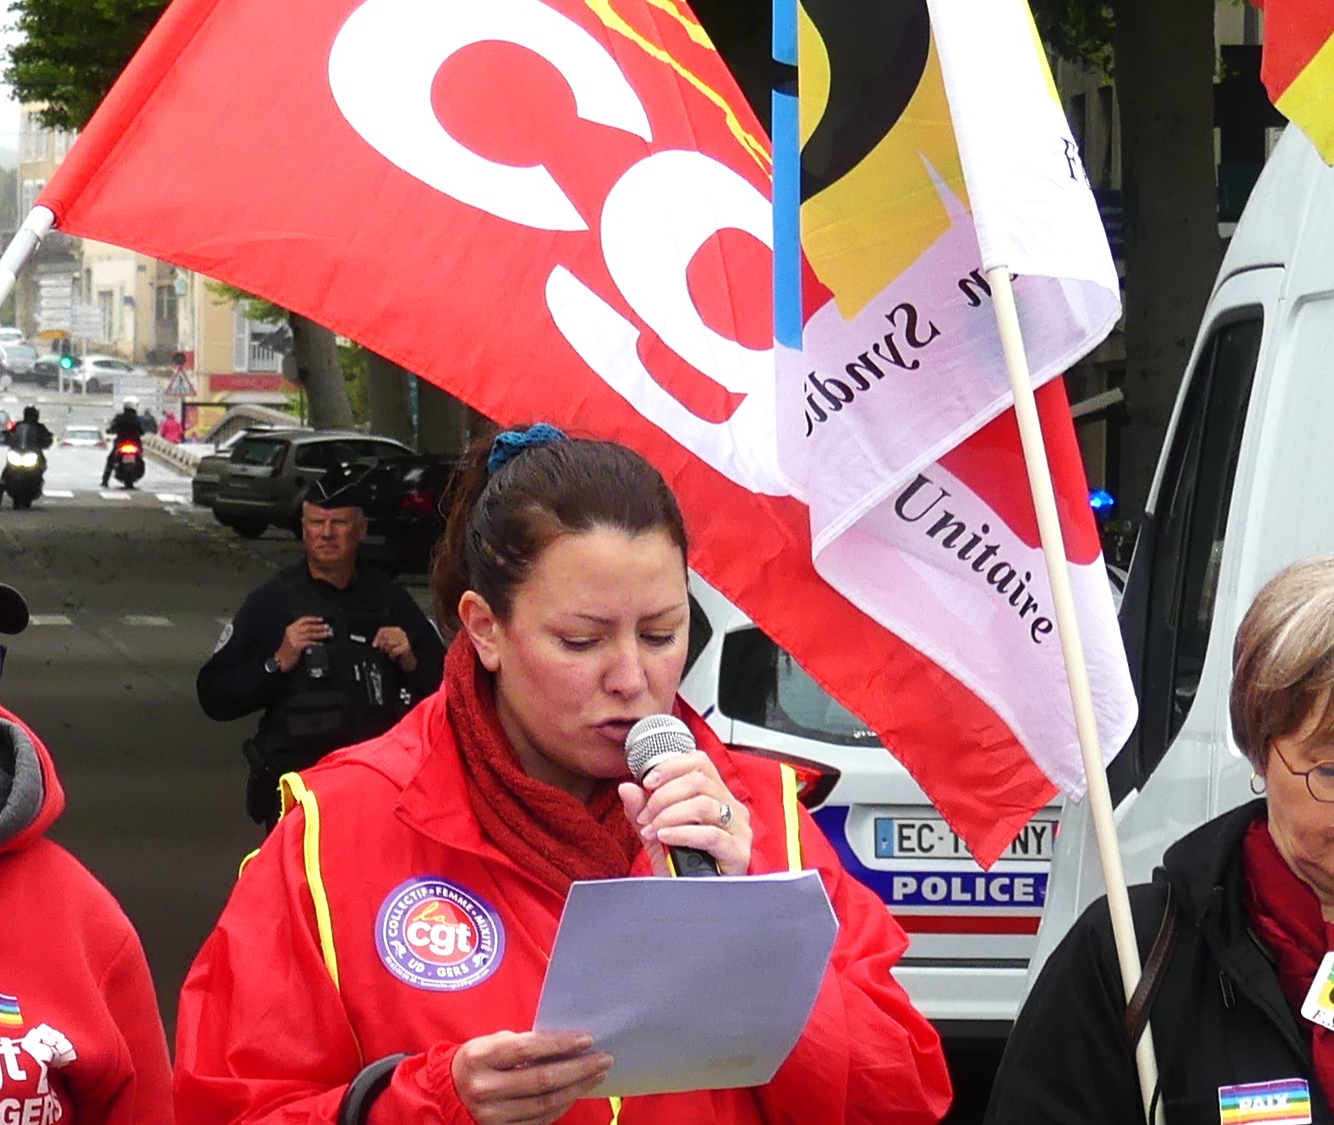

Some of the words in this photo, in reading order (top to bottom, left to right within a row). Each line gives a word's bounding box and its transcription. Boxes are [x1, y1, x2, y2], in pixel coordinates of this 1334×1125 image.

[894, 473, 1054, 645] Unitaire
[892, 875, 1035, 902] POLICE
[388, 886, 429, 937] COLLECTIF
[436, 886, 474, 913] FEMME
[406, 920, 472, 956] cgt
[407, 957, 425, 973] UD
[436, 962, 470, 978] GERS
[1237, 1093, 1291, 1113] PAIX
